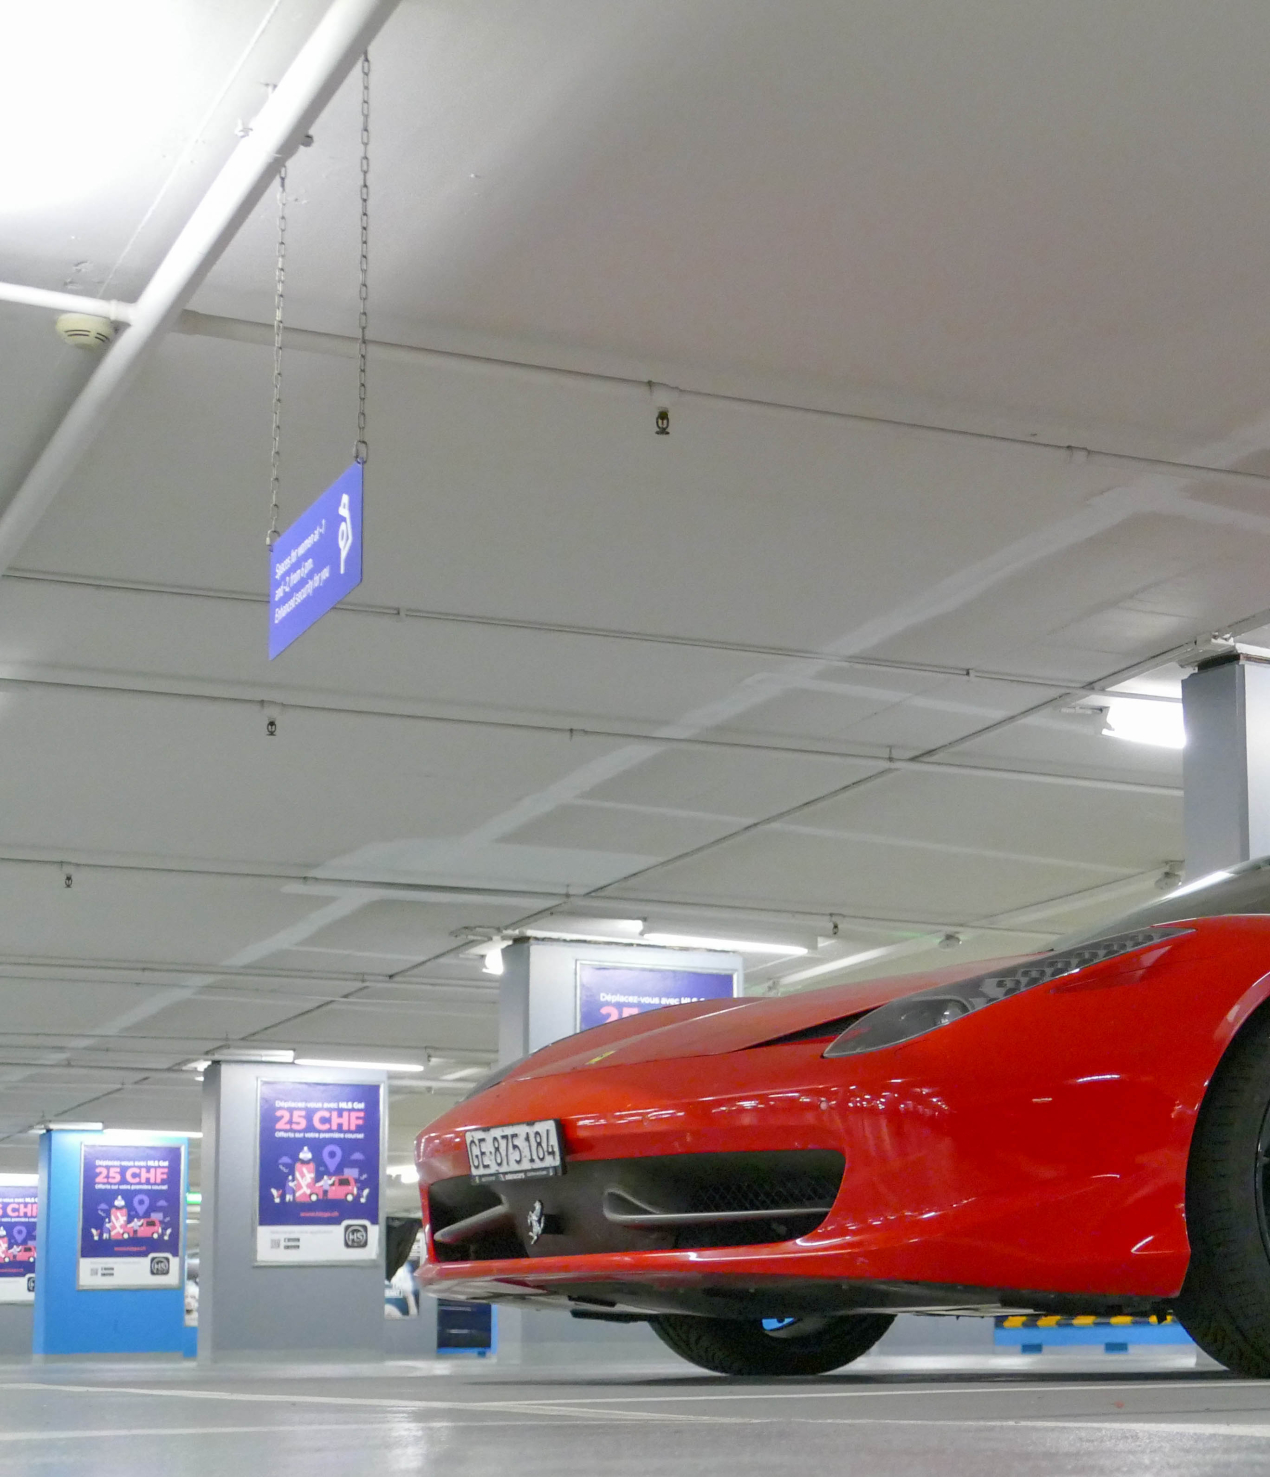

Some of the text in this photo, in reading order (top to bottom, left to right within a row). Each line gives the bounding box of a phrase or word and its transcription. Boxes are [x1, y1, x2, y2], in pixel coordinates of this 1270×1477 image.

[600, 993, 660, 1005] Déplacez-vous
[660, 997, 681, 1005] avec
[275, 1109, 365, 1131] 25 CHF
[95, 1166, 169, 1184] 25 CHF
